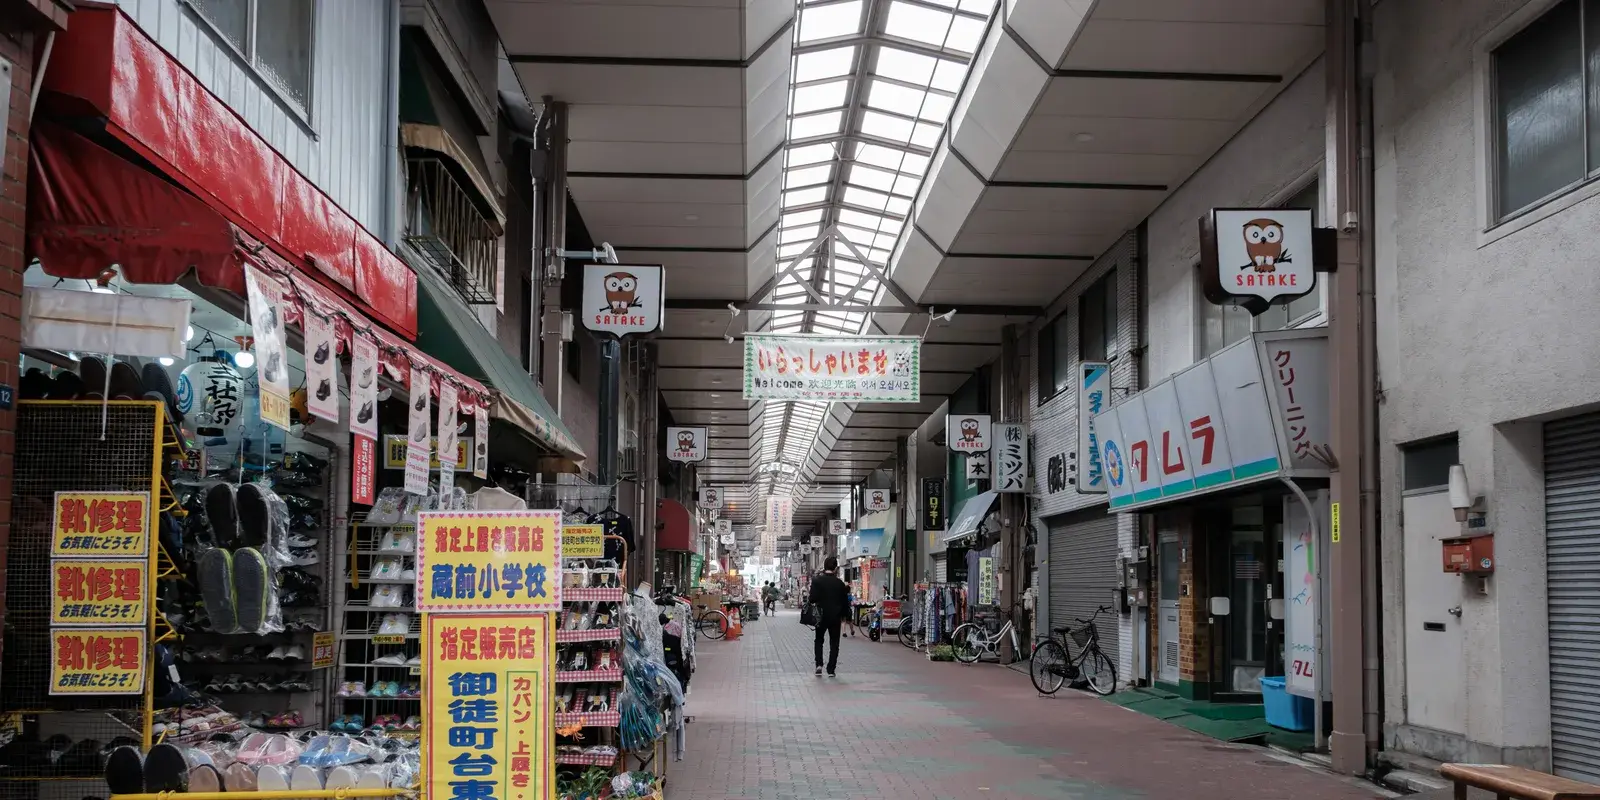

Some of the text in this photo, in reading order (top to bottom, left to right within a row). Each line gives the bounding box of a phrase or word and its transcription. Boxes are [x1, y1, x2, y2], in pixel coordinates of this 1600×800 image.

[1237, 274, 1297, 286] SATAKE
[595, 314, 645, 326] SATAKE
[758, 346, 888, 375] いらっしゃいませ
[755, 378, 803, 389] Welcome
[1275, 351, 1311, 459] クリーニング
[1132, 416, 1215, 483] タムラ
[60, 499, 141, 533] 靴修理
[930, 497, 938, 526] ロッキー
[435, 526, 544, 552] 指定上履き販売店
[57, 567, 140, 601] 靴修理
[431, 563, 546, 599] 蔵前小学校
[57, 636, 138, 670] 靴修理
[440, 625, 536, 661] 指定販売店
[448, 672, 498, 800] 御徒町台東
